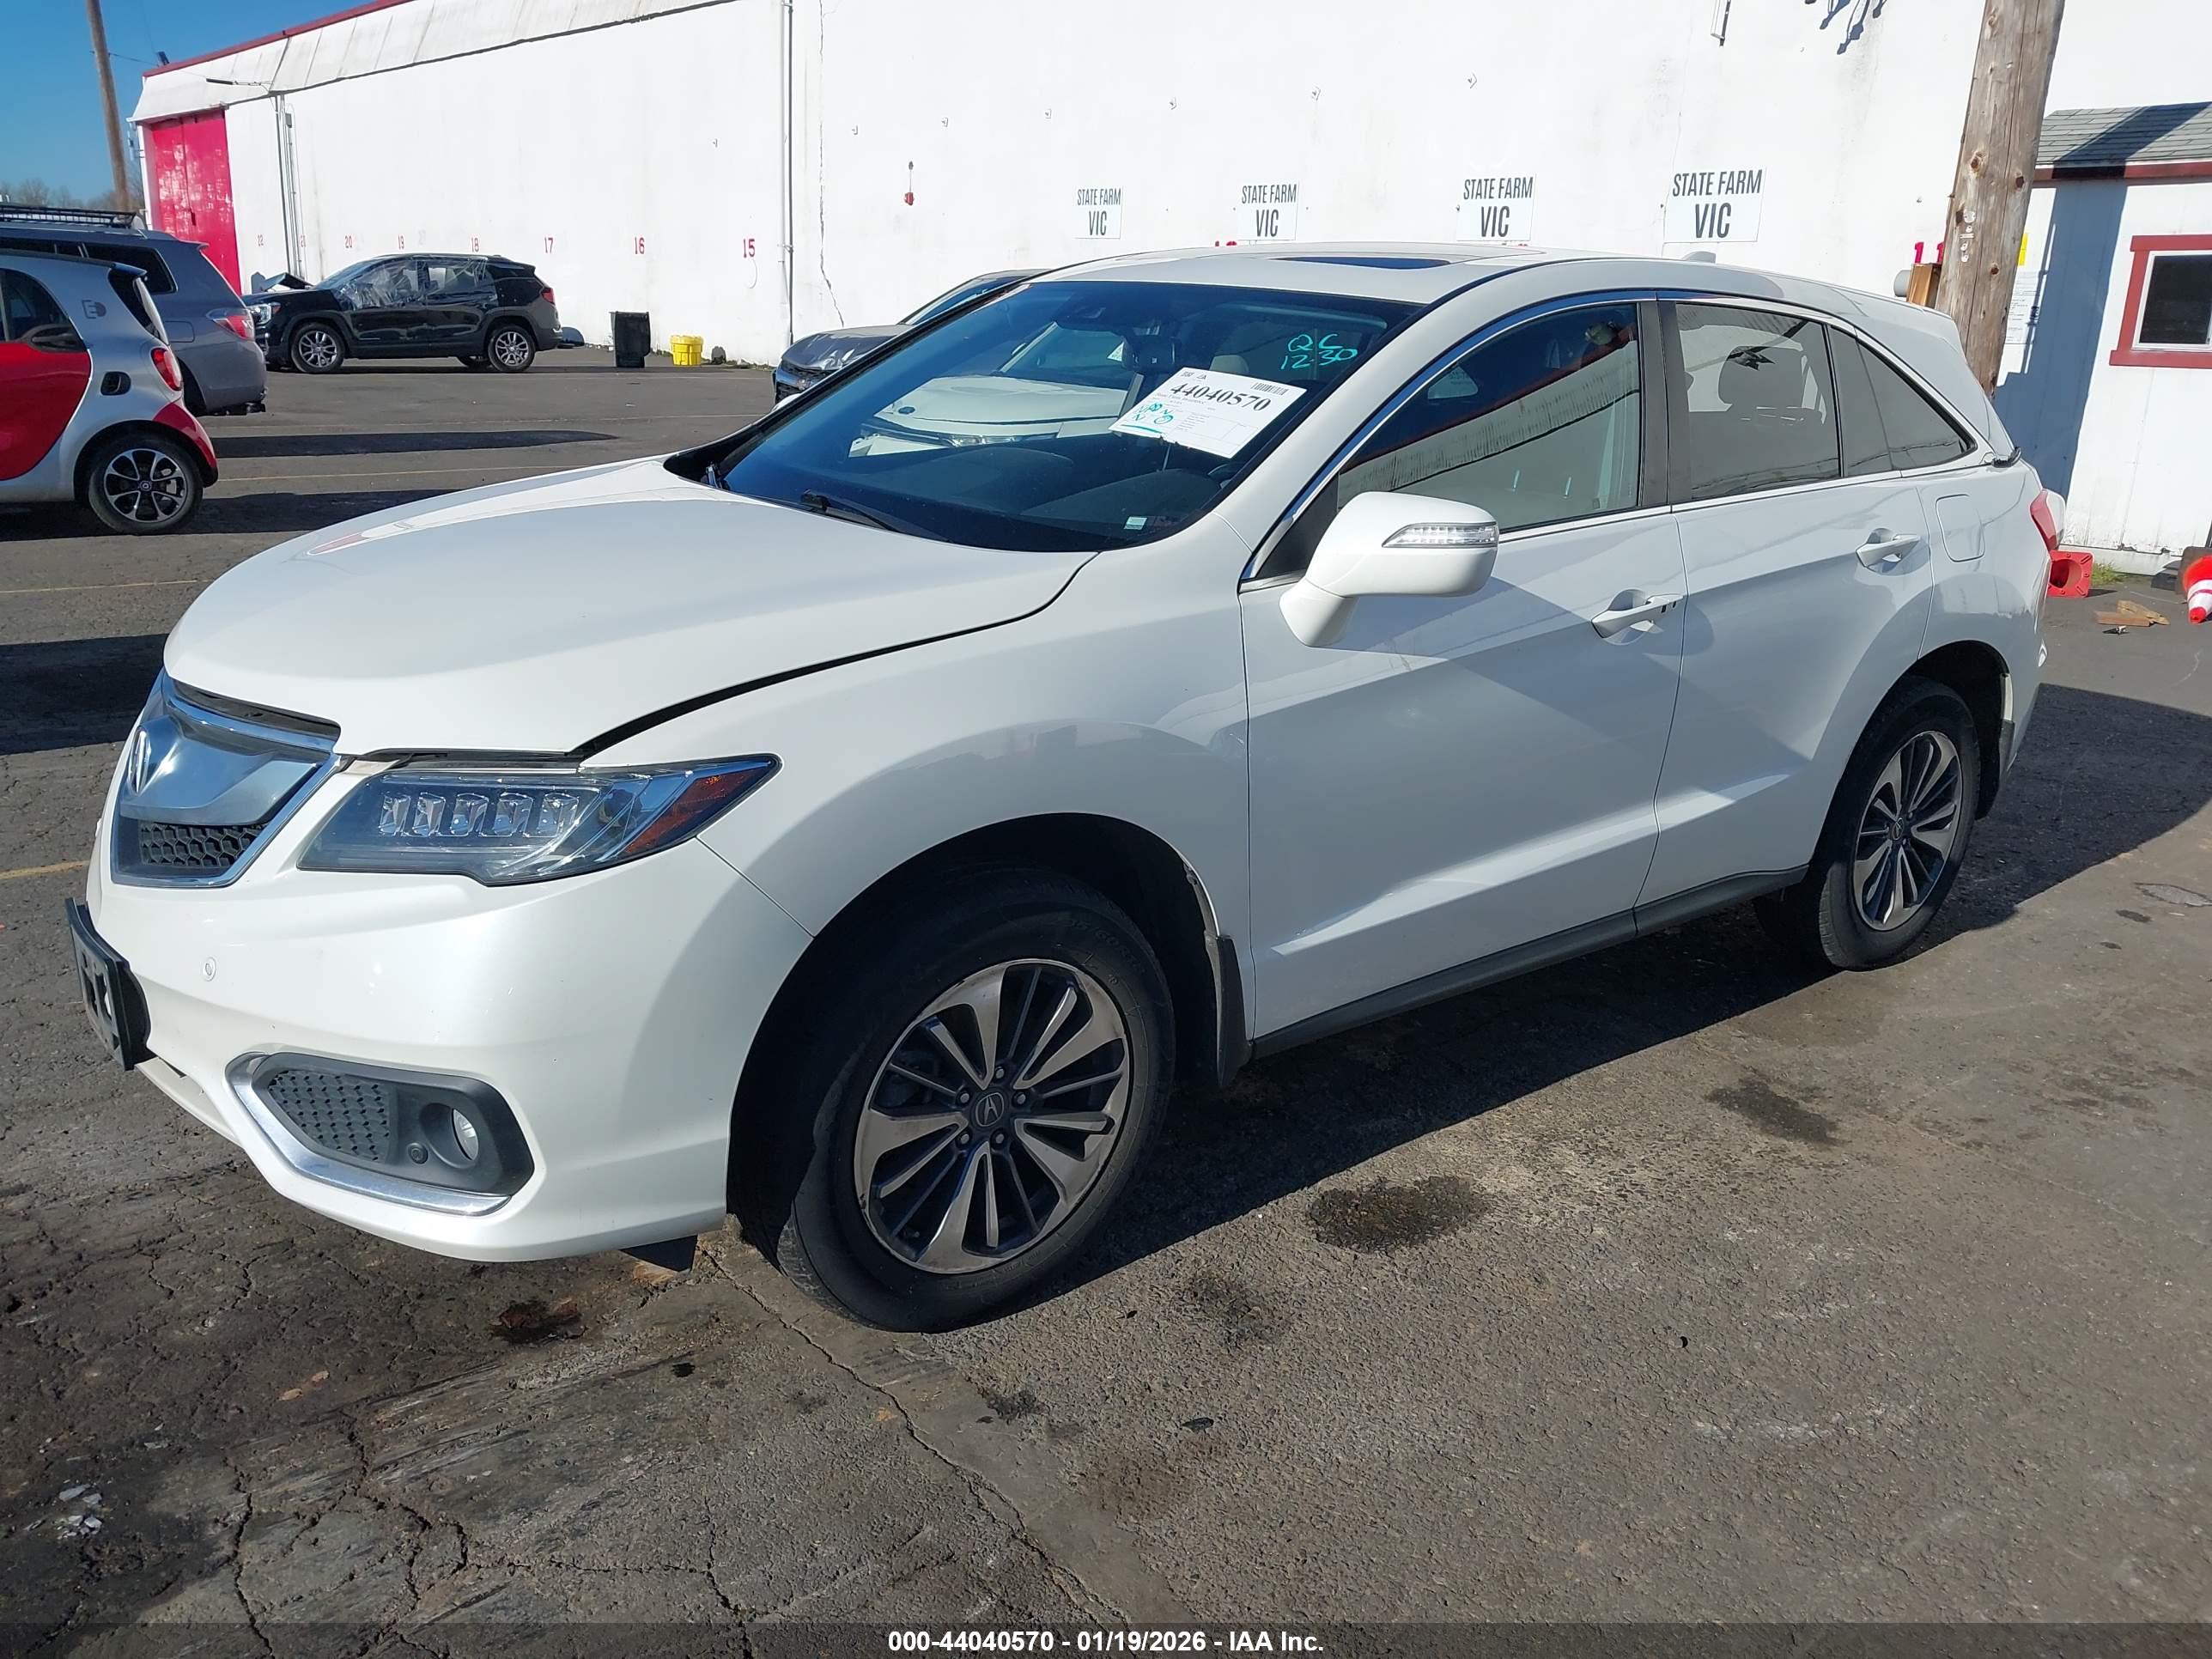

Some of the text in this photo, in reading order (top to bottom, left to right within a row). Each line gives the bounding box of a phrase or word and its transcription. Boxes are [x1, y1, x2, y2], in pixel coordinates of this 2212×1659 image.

[1463, 177, 1534, 200] STATE FARM
[1672, 169, 1763, 198] STATE FARM
[1077, 188, 1121, 206] STATE FARM
[1242, 184, 1297, 204] STATE FARM
[1089, 210, 1108, 236] VIC
[1255, 209, 1279, 238] VIC
[1480, 205, 1510, 238] VIC
[1695, 202, 1732, 239] VIC
[344, 235, 353, 249] 20
[398, 234, 405, 250] 19
[471, 237, 480, 252] 18
[544, 237, 554, 254] 17
[634, 237, 645, 255] 16
[743, 239, 756, 258] 15
[1170, 383, 1272, 411] 44040570
